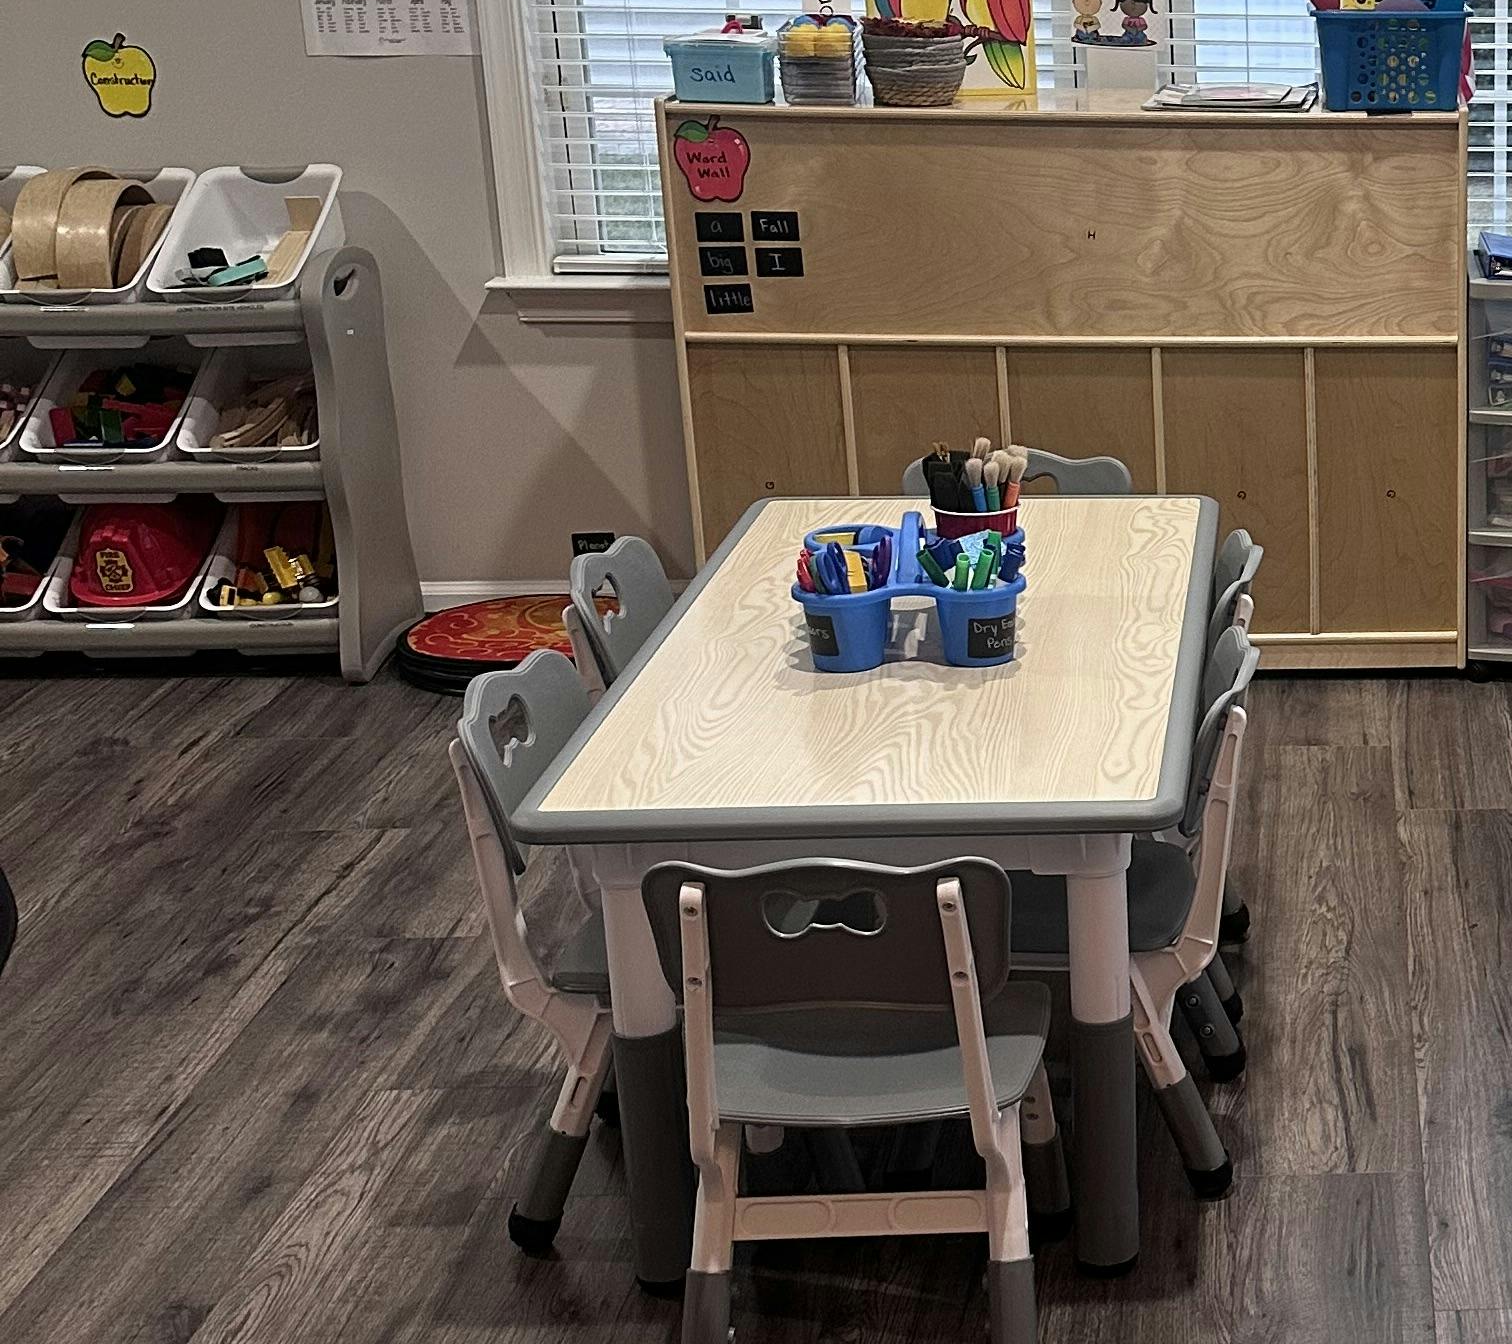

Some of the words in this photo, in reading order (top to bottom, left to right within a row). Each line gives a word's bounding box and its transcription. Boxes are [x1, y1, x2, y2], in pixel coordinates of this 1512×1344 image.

[90, 73, 153, 85] Construction
[687, 152, 727, 164] Word
[697, 167, 730, 178] Wall
[710, 219, 723, 233] a
[760, 219, 789, 234] Fall
[708, 251, 733, 274] big
[769, 253, 786, 271] I
[710, 289, 750, 307] little
[973, 622, 997, 637] Dry
